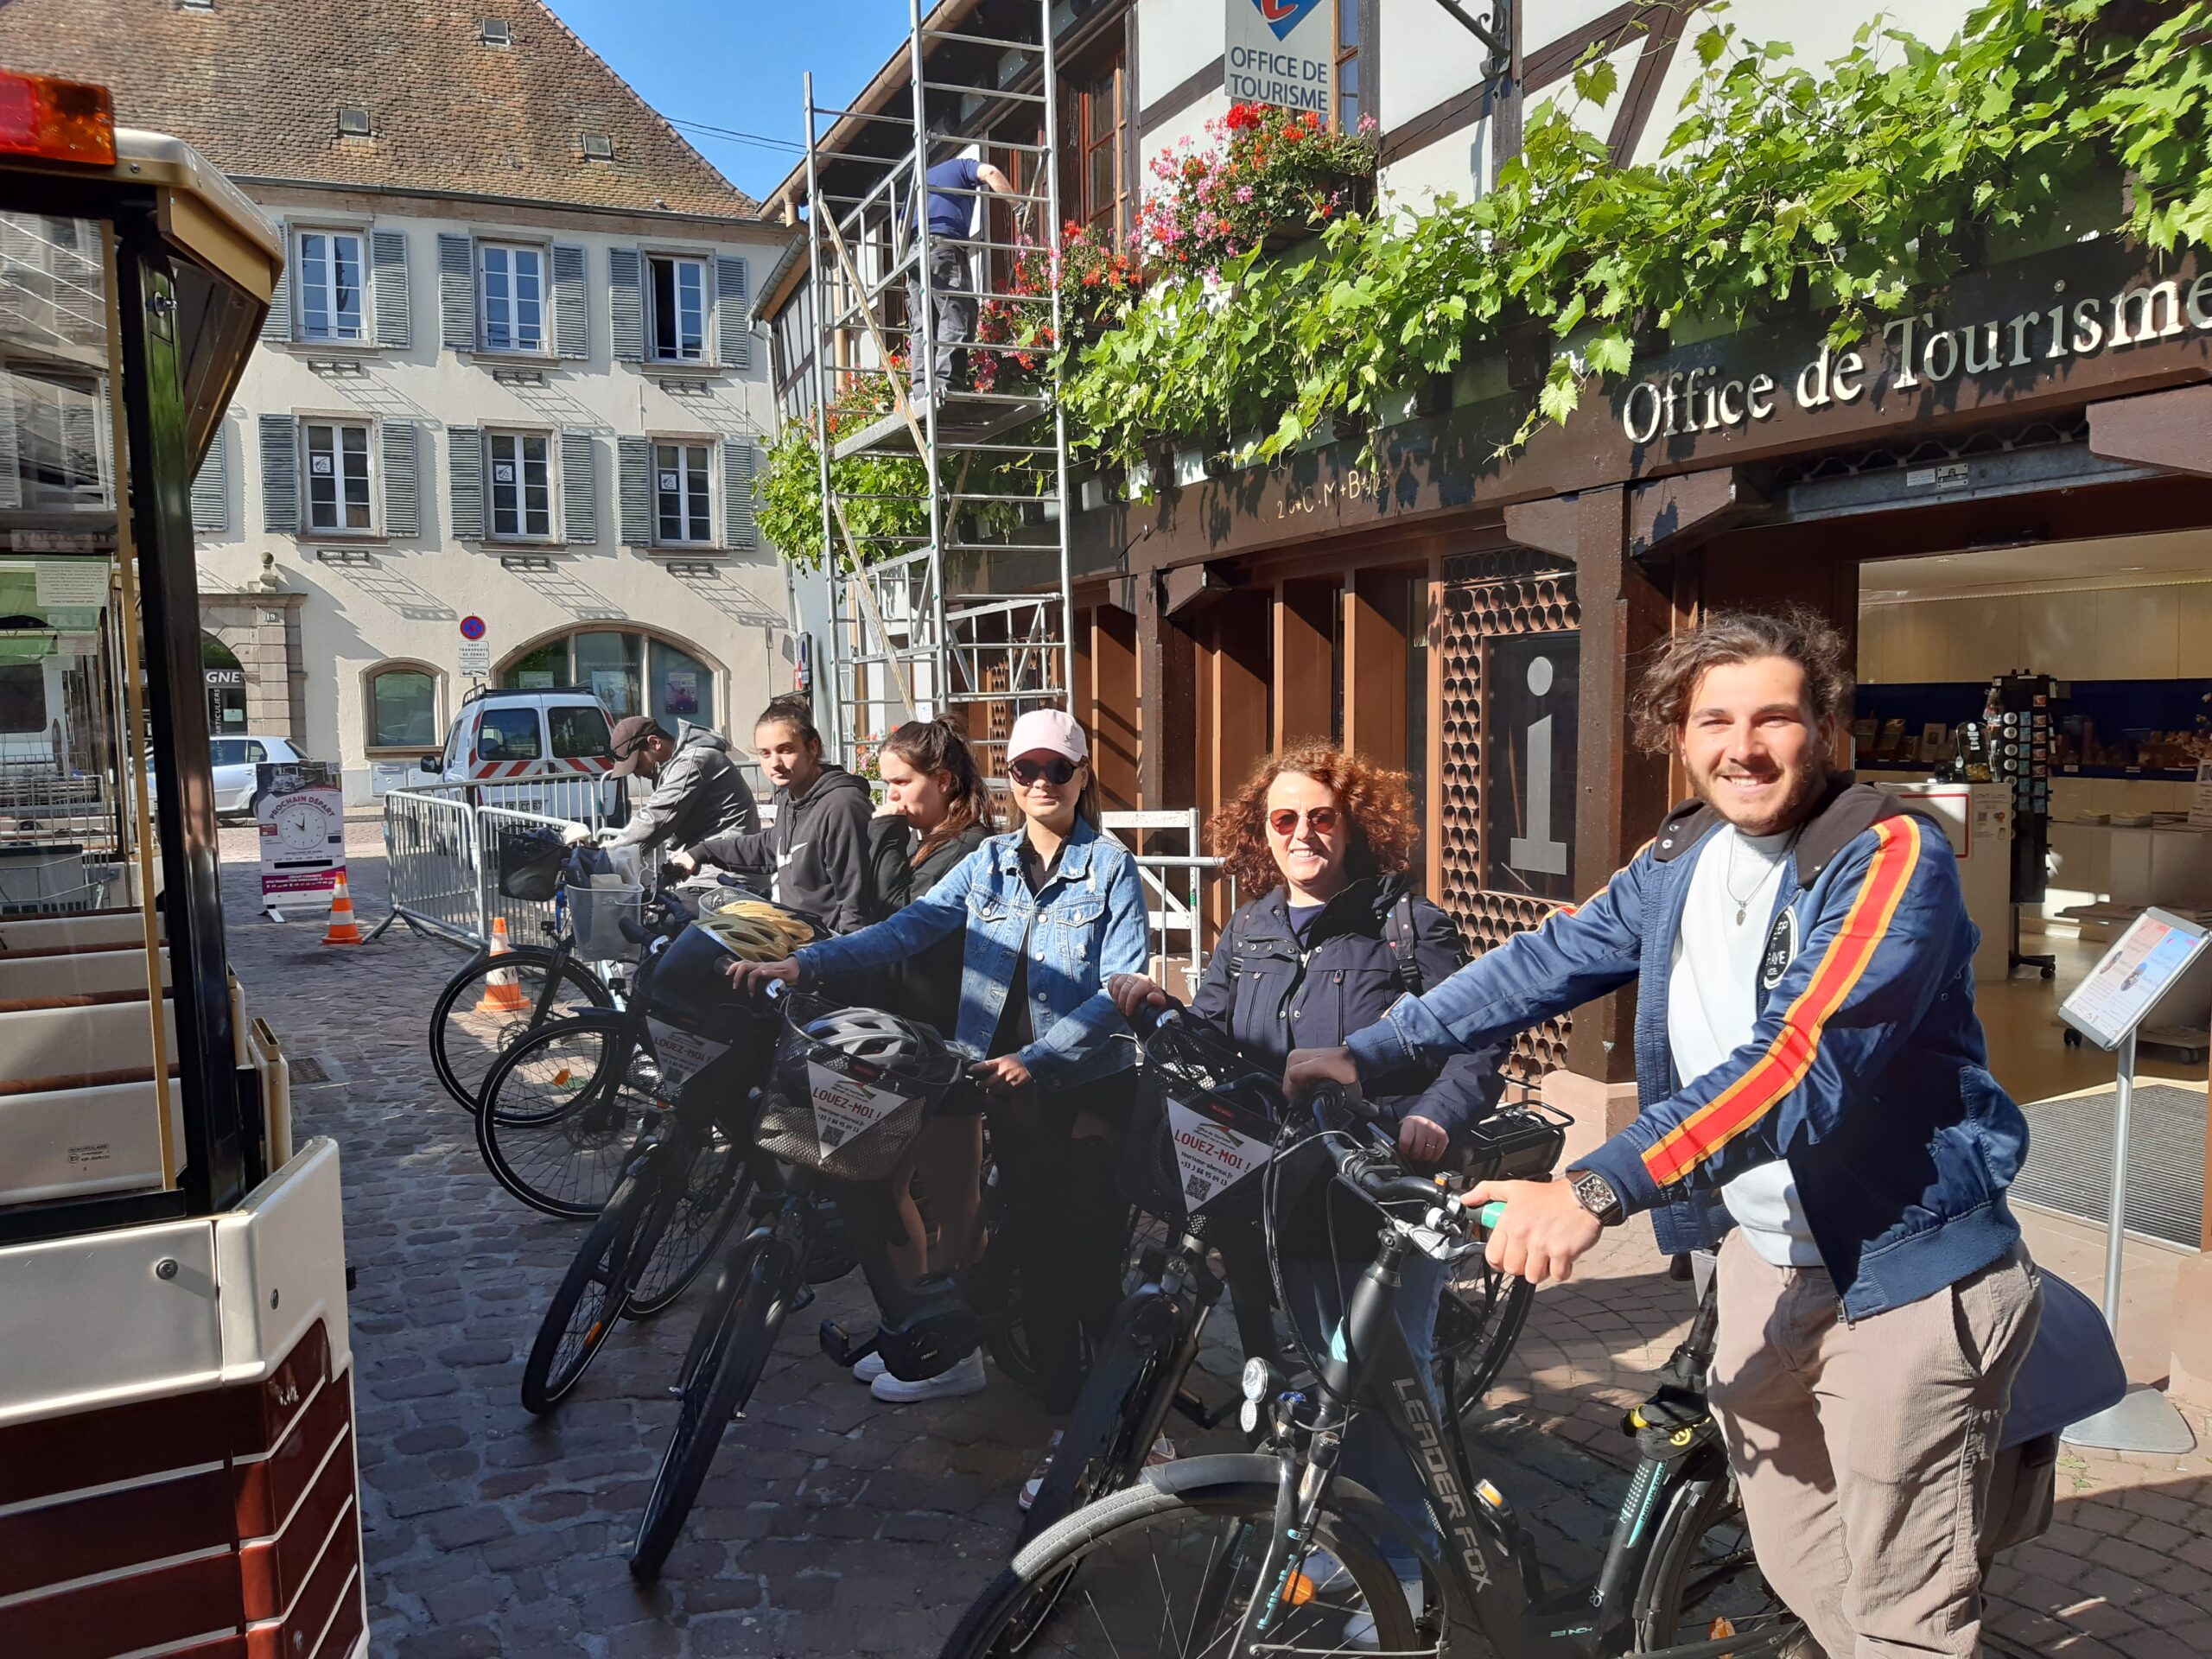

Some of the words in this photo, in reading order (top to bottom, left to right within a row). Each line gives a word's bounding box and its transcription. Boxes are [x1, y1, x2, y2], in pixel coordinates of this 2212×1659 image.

[1230, 46, 1298, 79] OFFICE
[1302, 60, 1328, 84] DE
[1230, 73, 1328, 111] TOURISME
[1622, 365, 1776, 445] Office
[1796, 338, 1866, 409] de
[1882, 270, 2212, 391] Tourisme
[266, 613, 276, 621] 19
[213, 688, 222, 736] ARTICULIERS
[270, 795, 308, 820] PROCHAIN
[308, 796, 336, 817] DÉPART
[654, 1036, 706, 1062] LOUEZ-MOI
[812, 1086, 875, 1120] LOUEZ-MOI
[875, 1111, 882, 1122] !
[1173, 1128, 1243, 1170] LOUEZ-MOI
[1243, 1162, 1252, 1173] !
[1180, 1150, 1234, 1179] tourisme-obernai.fr
[1220, 1178, 1228, 1186] 13
[1395, 1376, 1467, 1522] LEADER
[1453, 1526, 1493, 1594] FOX
